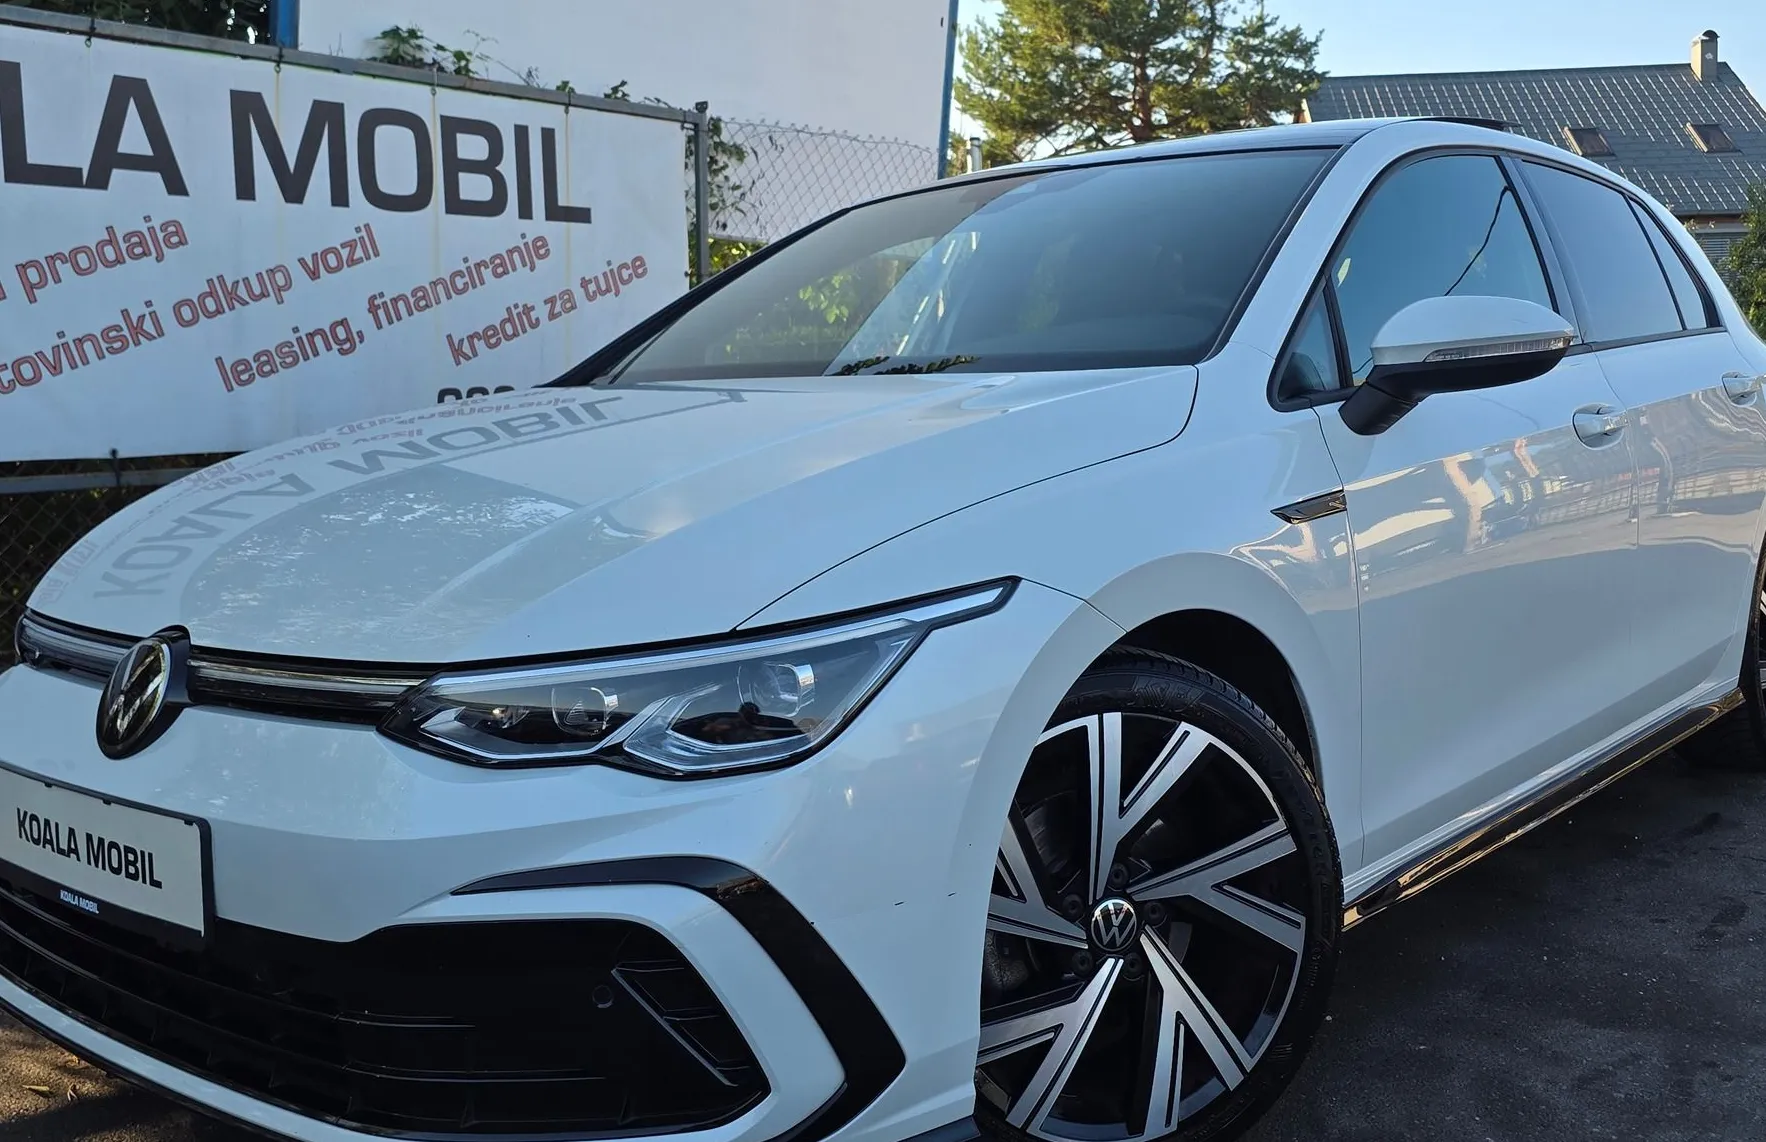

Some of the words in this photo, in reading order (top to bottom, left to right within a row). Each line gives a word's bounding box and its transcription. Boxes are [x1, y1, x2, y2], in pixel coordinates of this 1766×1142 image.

[229, 89, 592, 224] MOBIL
[15, 215, 190, 304] prodaja
[172, 264, 293, 328] odkup
[297, 223, 381, 281] vozil
[446, 302, 541, 366] kredit
[543, 287, 577, 322] za
[580, 253, 649, 302] tujce
[215, 316, 365, 393] leasing,
[367, 233, 551, 331] financiranje
[16, 807, 81, 862] KOALA
[85, 832, 163, 889] MOBIL
[60, 889, 79, 906] KOALA
[79, 897, 100, 914] MOBIL
